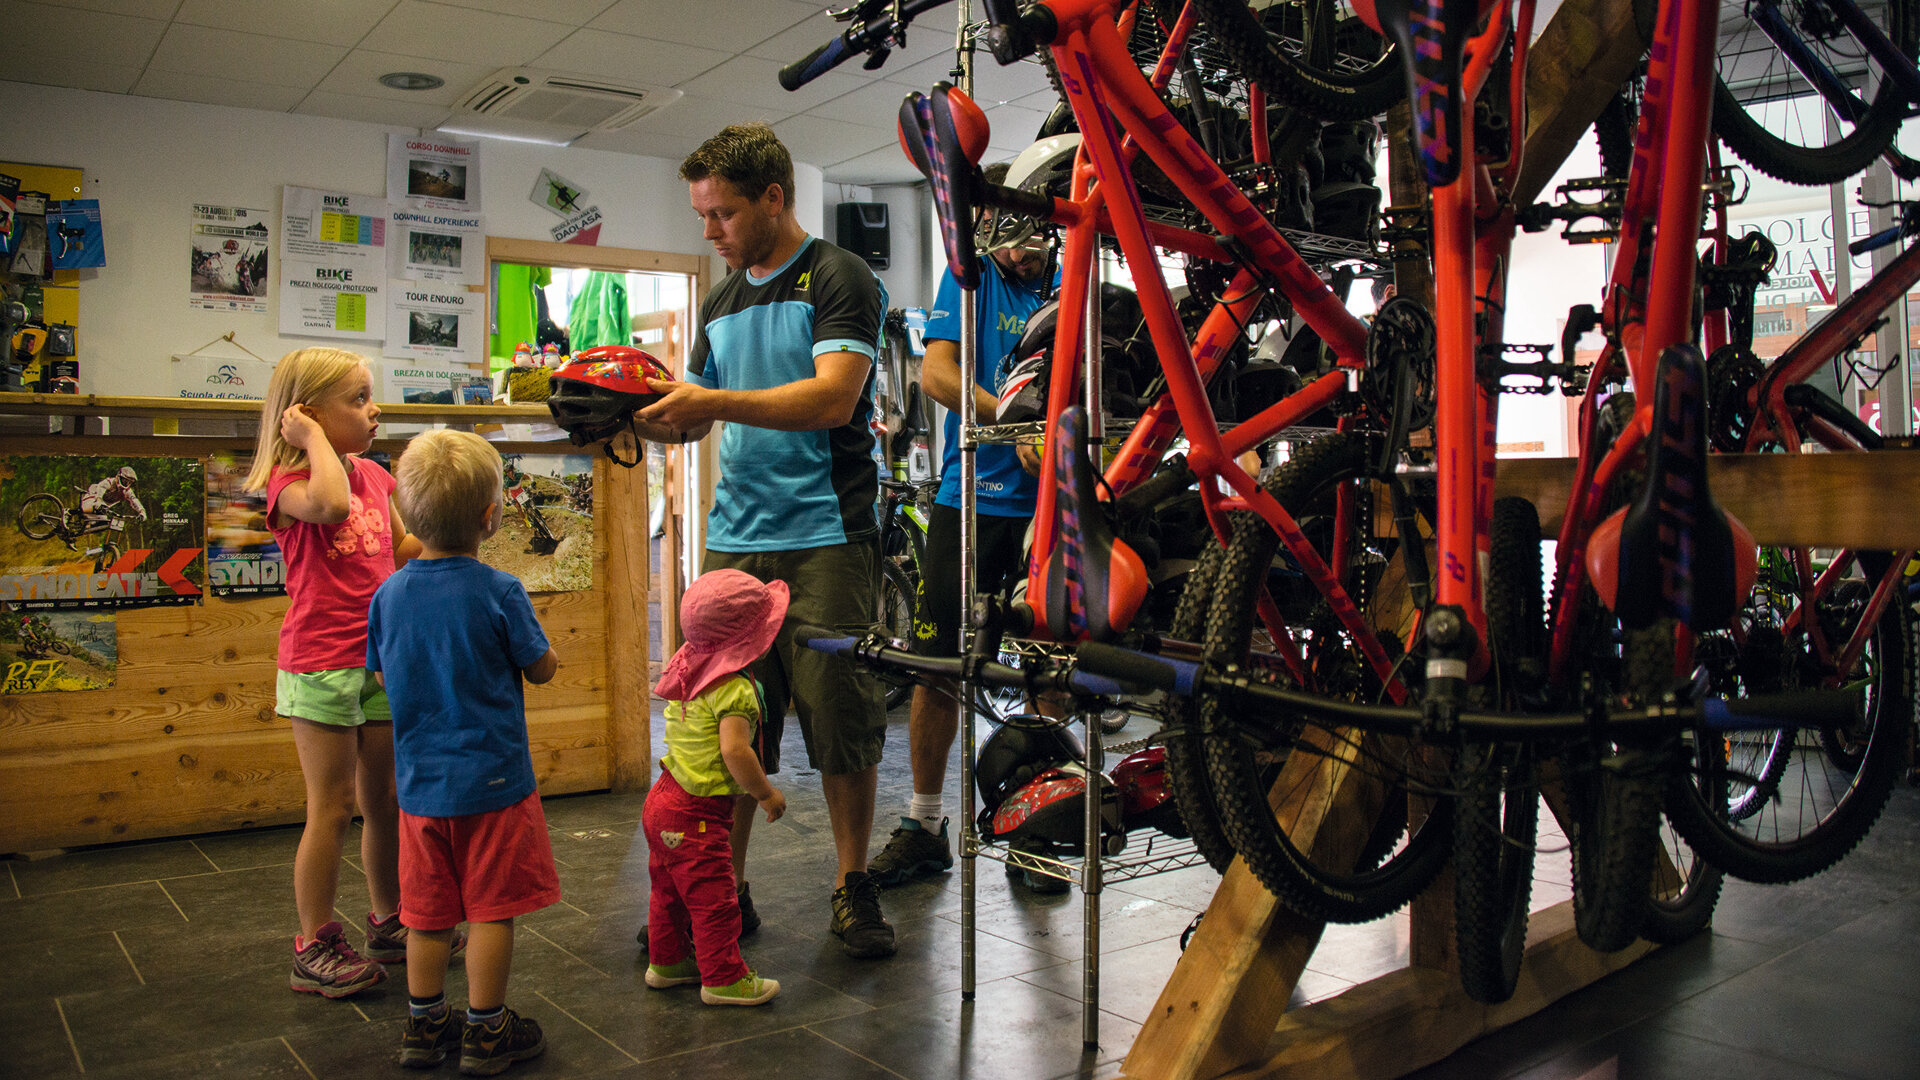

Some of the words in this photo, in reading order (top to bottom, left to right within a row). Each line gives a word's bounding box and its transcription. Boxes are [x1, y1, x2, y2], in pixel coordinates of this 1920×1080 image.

[406, 141, 433, 151] CORSO
[434, 144, 471, 155] DOWNHILL
[323, 195, 349, 207] BIKE
[209, 207, 233, 216] AUGUST
[393, 212, 432, 223] DOWNHILL
[433, 216, 480, 227] EXPERIENCE
[555, 212, 602, 241] DAOLASA
[316, 268, 353, 282] BIKE
[312, 282, 342, 290] NOLEGGIO
[342, 284, 378, 293] PROTEZIONI
[405, 291, 428, 302] TOUR
[430, 294, 464, 305] ENDURO
[394, 369, 425, 377] BREZZA
[426, 370, 434, 378] DI
[180, 389, 213, 399] Scuola
[0, 572, 158, 600] SYNDICATE
